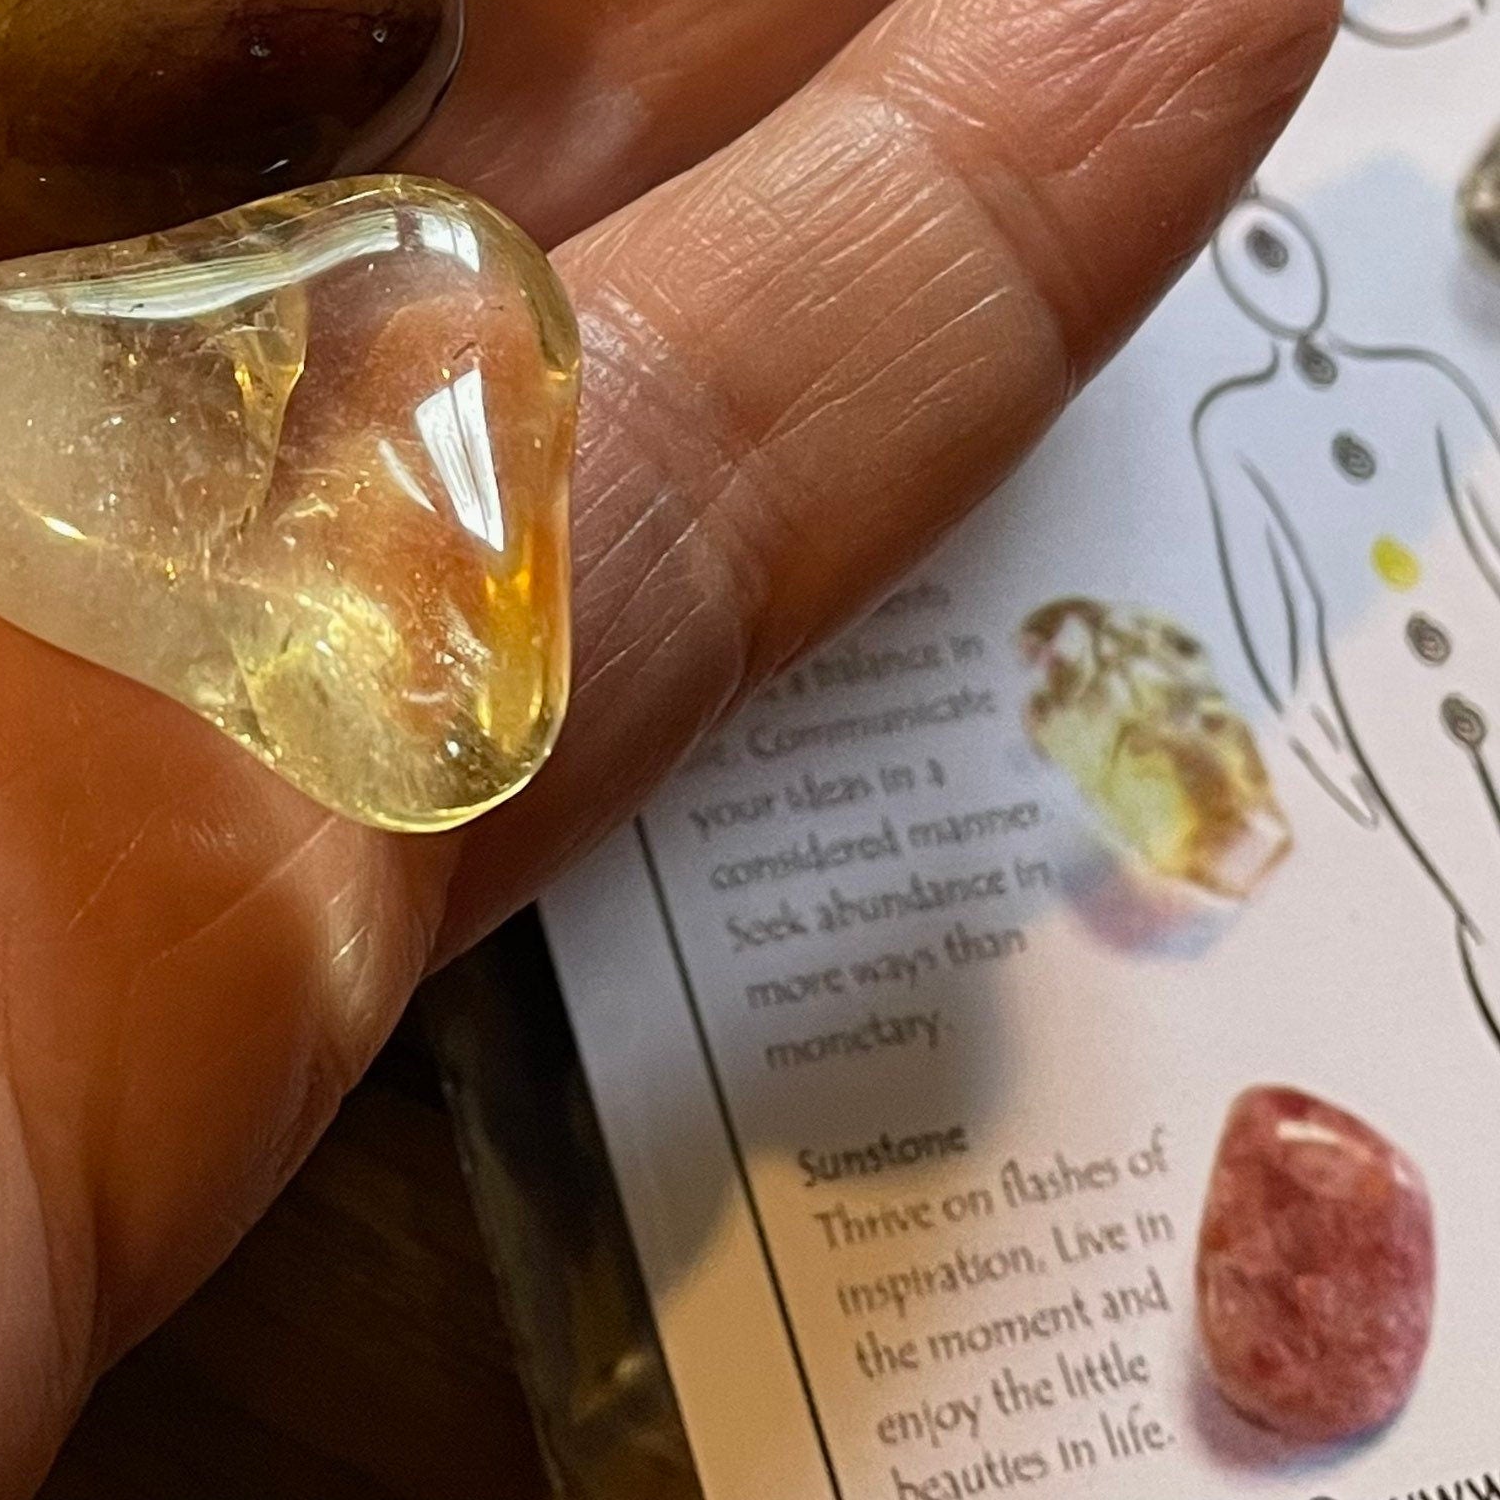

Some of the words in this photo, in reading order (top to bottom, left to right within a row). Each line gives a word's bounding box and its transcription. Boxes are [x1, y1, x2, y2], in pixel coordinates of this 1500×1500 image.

[688, 793, 777, 842] your
[785, 770, 875, 813] ideas
[879, 763, 916, 796] in
[927, 757, 946, 790] a
[709, 816, 902, 892] considered
[724, 900, 808, 952] Seek
[817, 868, 1006, 934] abundance
[1014, 857, 1054, 890] in
[746, 966, 845, 1008] more
[851, 945, 937, 990] ways
[943, 920, 1028, 967] than
[799, 1123, 970, 1187] Sunstone
[813, 1204, 936, 1252] Thrive
[940, 1188, 995, 1223] on
[1000, 1150, 1120, 1208] flashes
[1127, 1124, 1169, 1178] of
[837, 1246, 1047, 1319] inspiration.
[1051, 1220, 1130, 1265] Live
[1135, 1209, 1176, 1245] in
[854, 1330, 919, 1380] the
[928, 1291, 1093, 1361] moment
[1100, 1265, 1173, 1321] and
[876, 1395, 982, 1448] enjoy
[991, 1366, 1056, 1417] the
[1056, 1340, 1152, 1399] little
[891, 1450, 1049, 1500] beauties
[1056, 1435, 1097, 1471] in
[1100, 1404, 1176, 1459] life.
